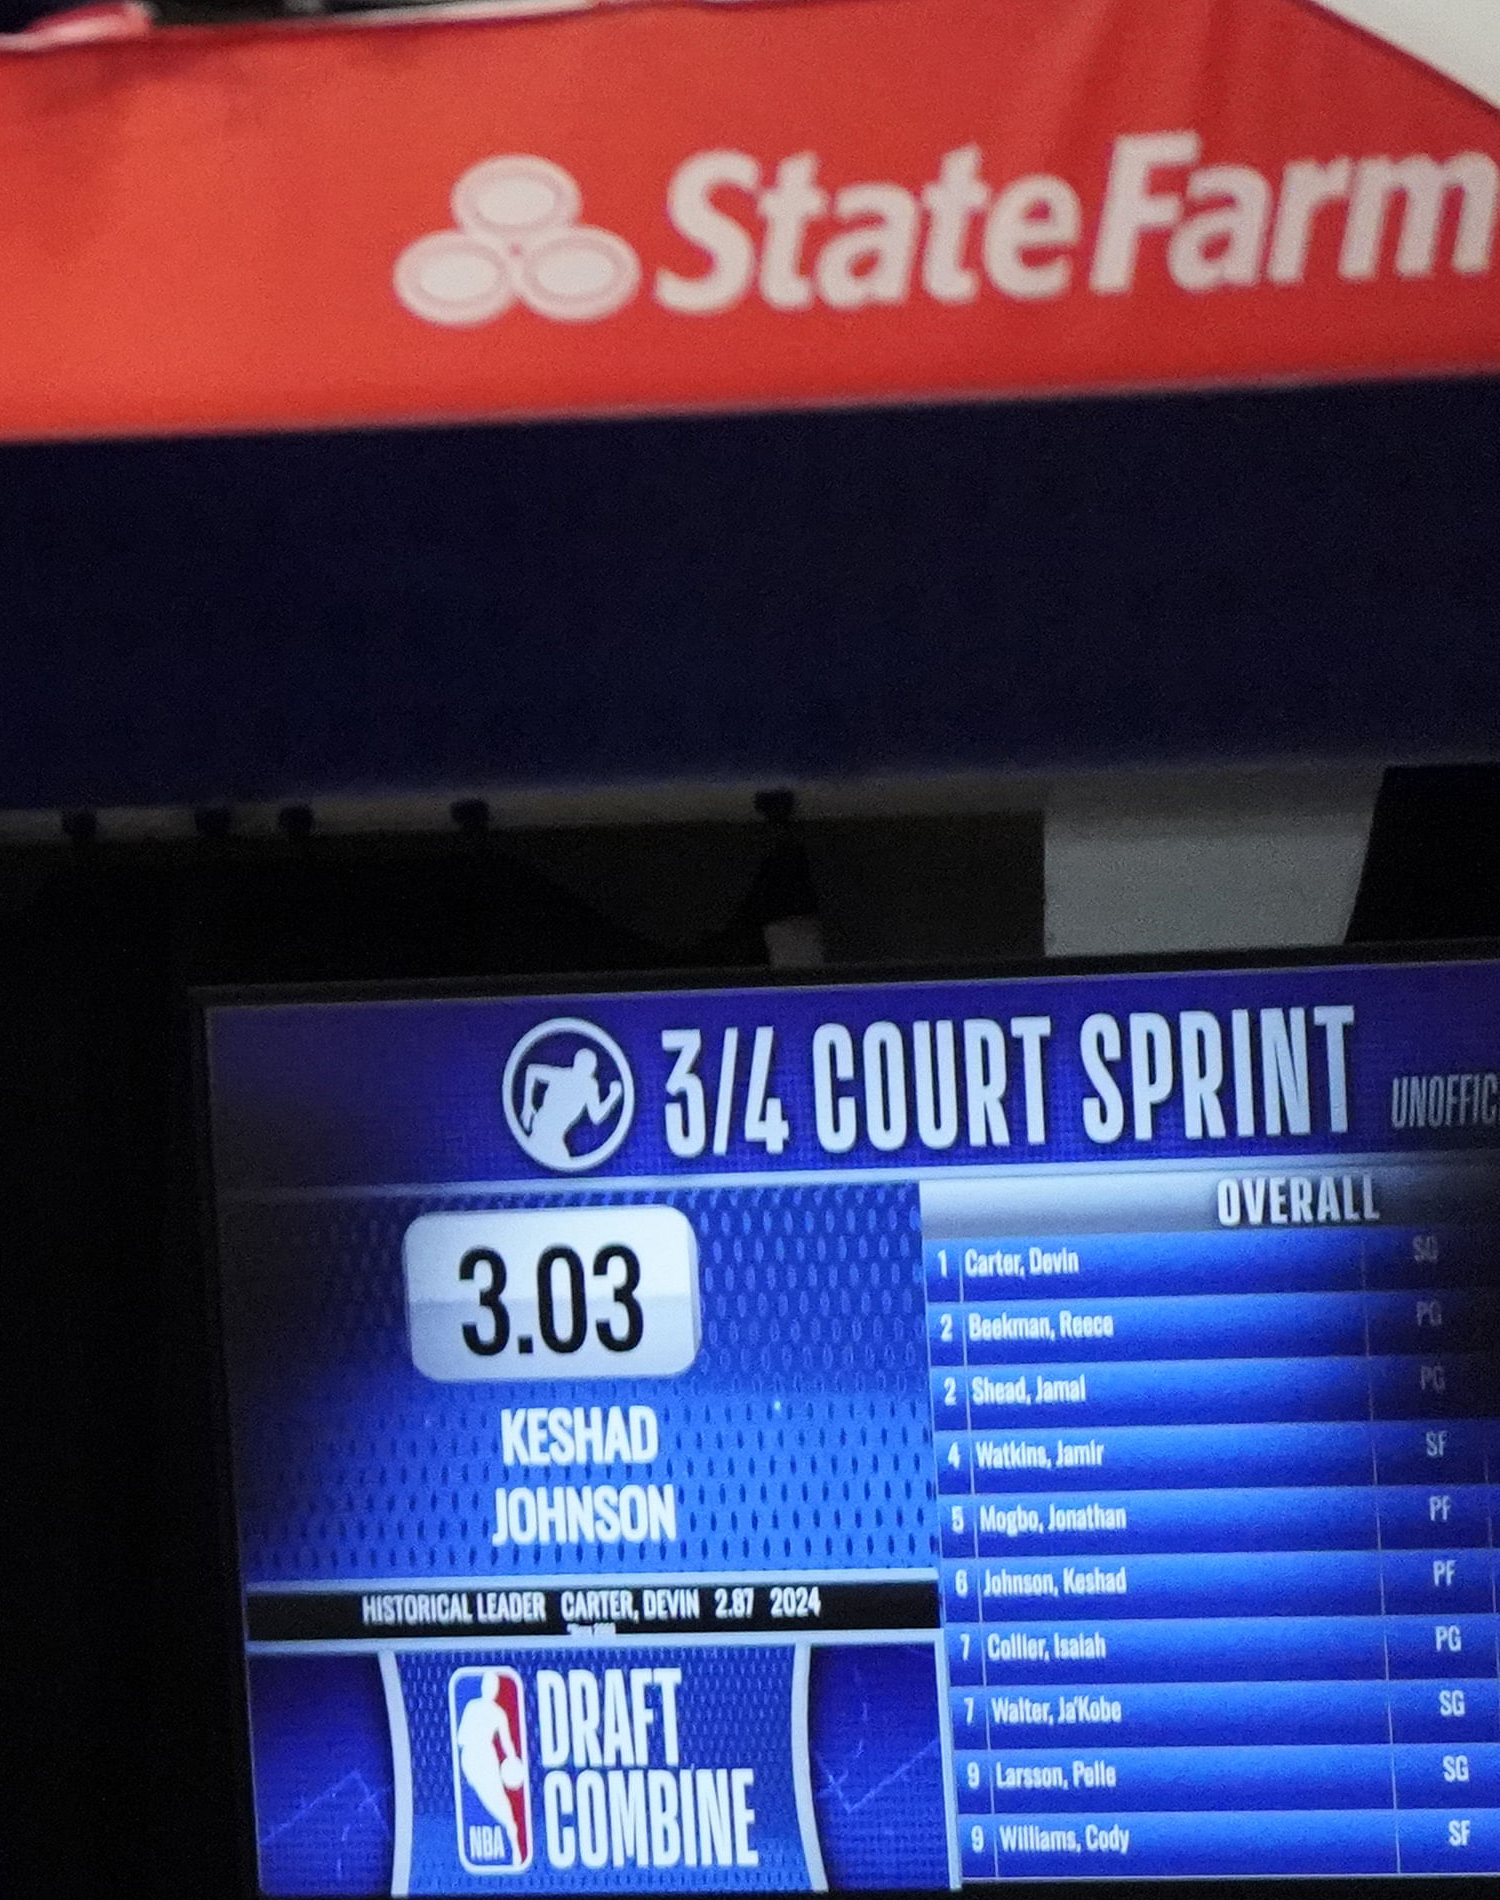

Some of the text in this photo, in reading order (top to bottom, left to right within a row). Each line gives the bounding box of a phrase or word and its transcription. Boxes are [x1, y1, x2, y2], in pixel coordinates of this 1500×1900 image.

[661, 1005, 1355, 1158] 3/4 COURT SPRINT
[1392, 1073, 1500, 1129] UNOFFIC
[1217, 1173, 1381, 1225] OVERALL
[938, 1247, 1079, 1277] 1 Carter, Devin
[459, 1244, 643, 1356] 3.03
[940, 1310, 1114, 1342] 2 Beekman, Reece
[944, 1374, 1086, 1406] 2 Shead, Jamal
[501, 1405, 659, 1466] KESHAD
[1426, 1430, 1449, 1458] SF
[948, 1439, 1104, 1470] 4 Watkins, Jamir
[492, 1484, 677, 1546] JOHNSON
[951, 1502, 1127, 1537] 5 Mogbo, Jonathan
[1429, 1495, 1451, 1522] PF
[955, 1567, 1127, 1598] 6 Johnson, Keshad
[1432, 1559, 1456, 1587] PF
[362, 1586, 821, 1625] HISTORICAL LEADER CARTER, DEVIN 2.87 2024
[960, 1632, 1107, 1662] 7 Collier, Isaiah
[1435, 1625, 1462, 1652] PG
[536, 1667, 682, 1768] DRAFT
[964, 1695, 1122, 1726] 7 Walter, Ja'Kobe
[1439, 1690, 1465, 1717] SG
[967, 1760, 1117, 1790] 9 Larsson, Pelle
[1443, 1755, 1469, 1782] SG
[544, 1767, 759, 1869] COMBINE
[1448, 1820, 1470, 1846] SF
[468, 1825, 506, 1861] NBA
[971, 1823, 1130, 1855] 9 Williams, Cody
